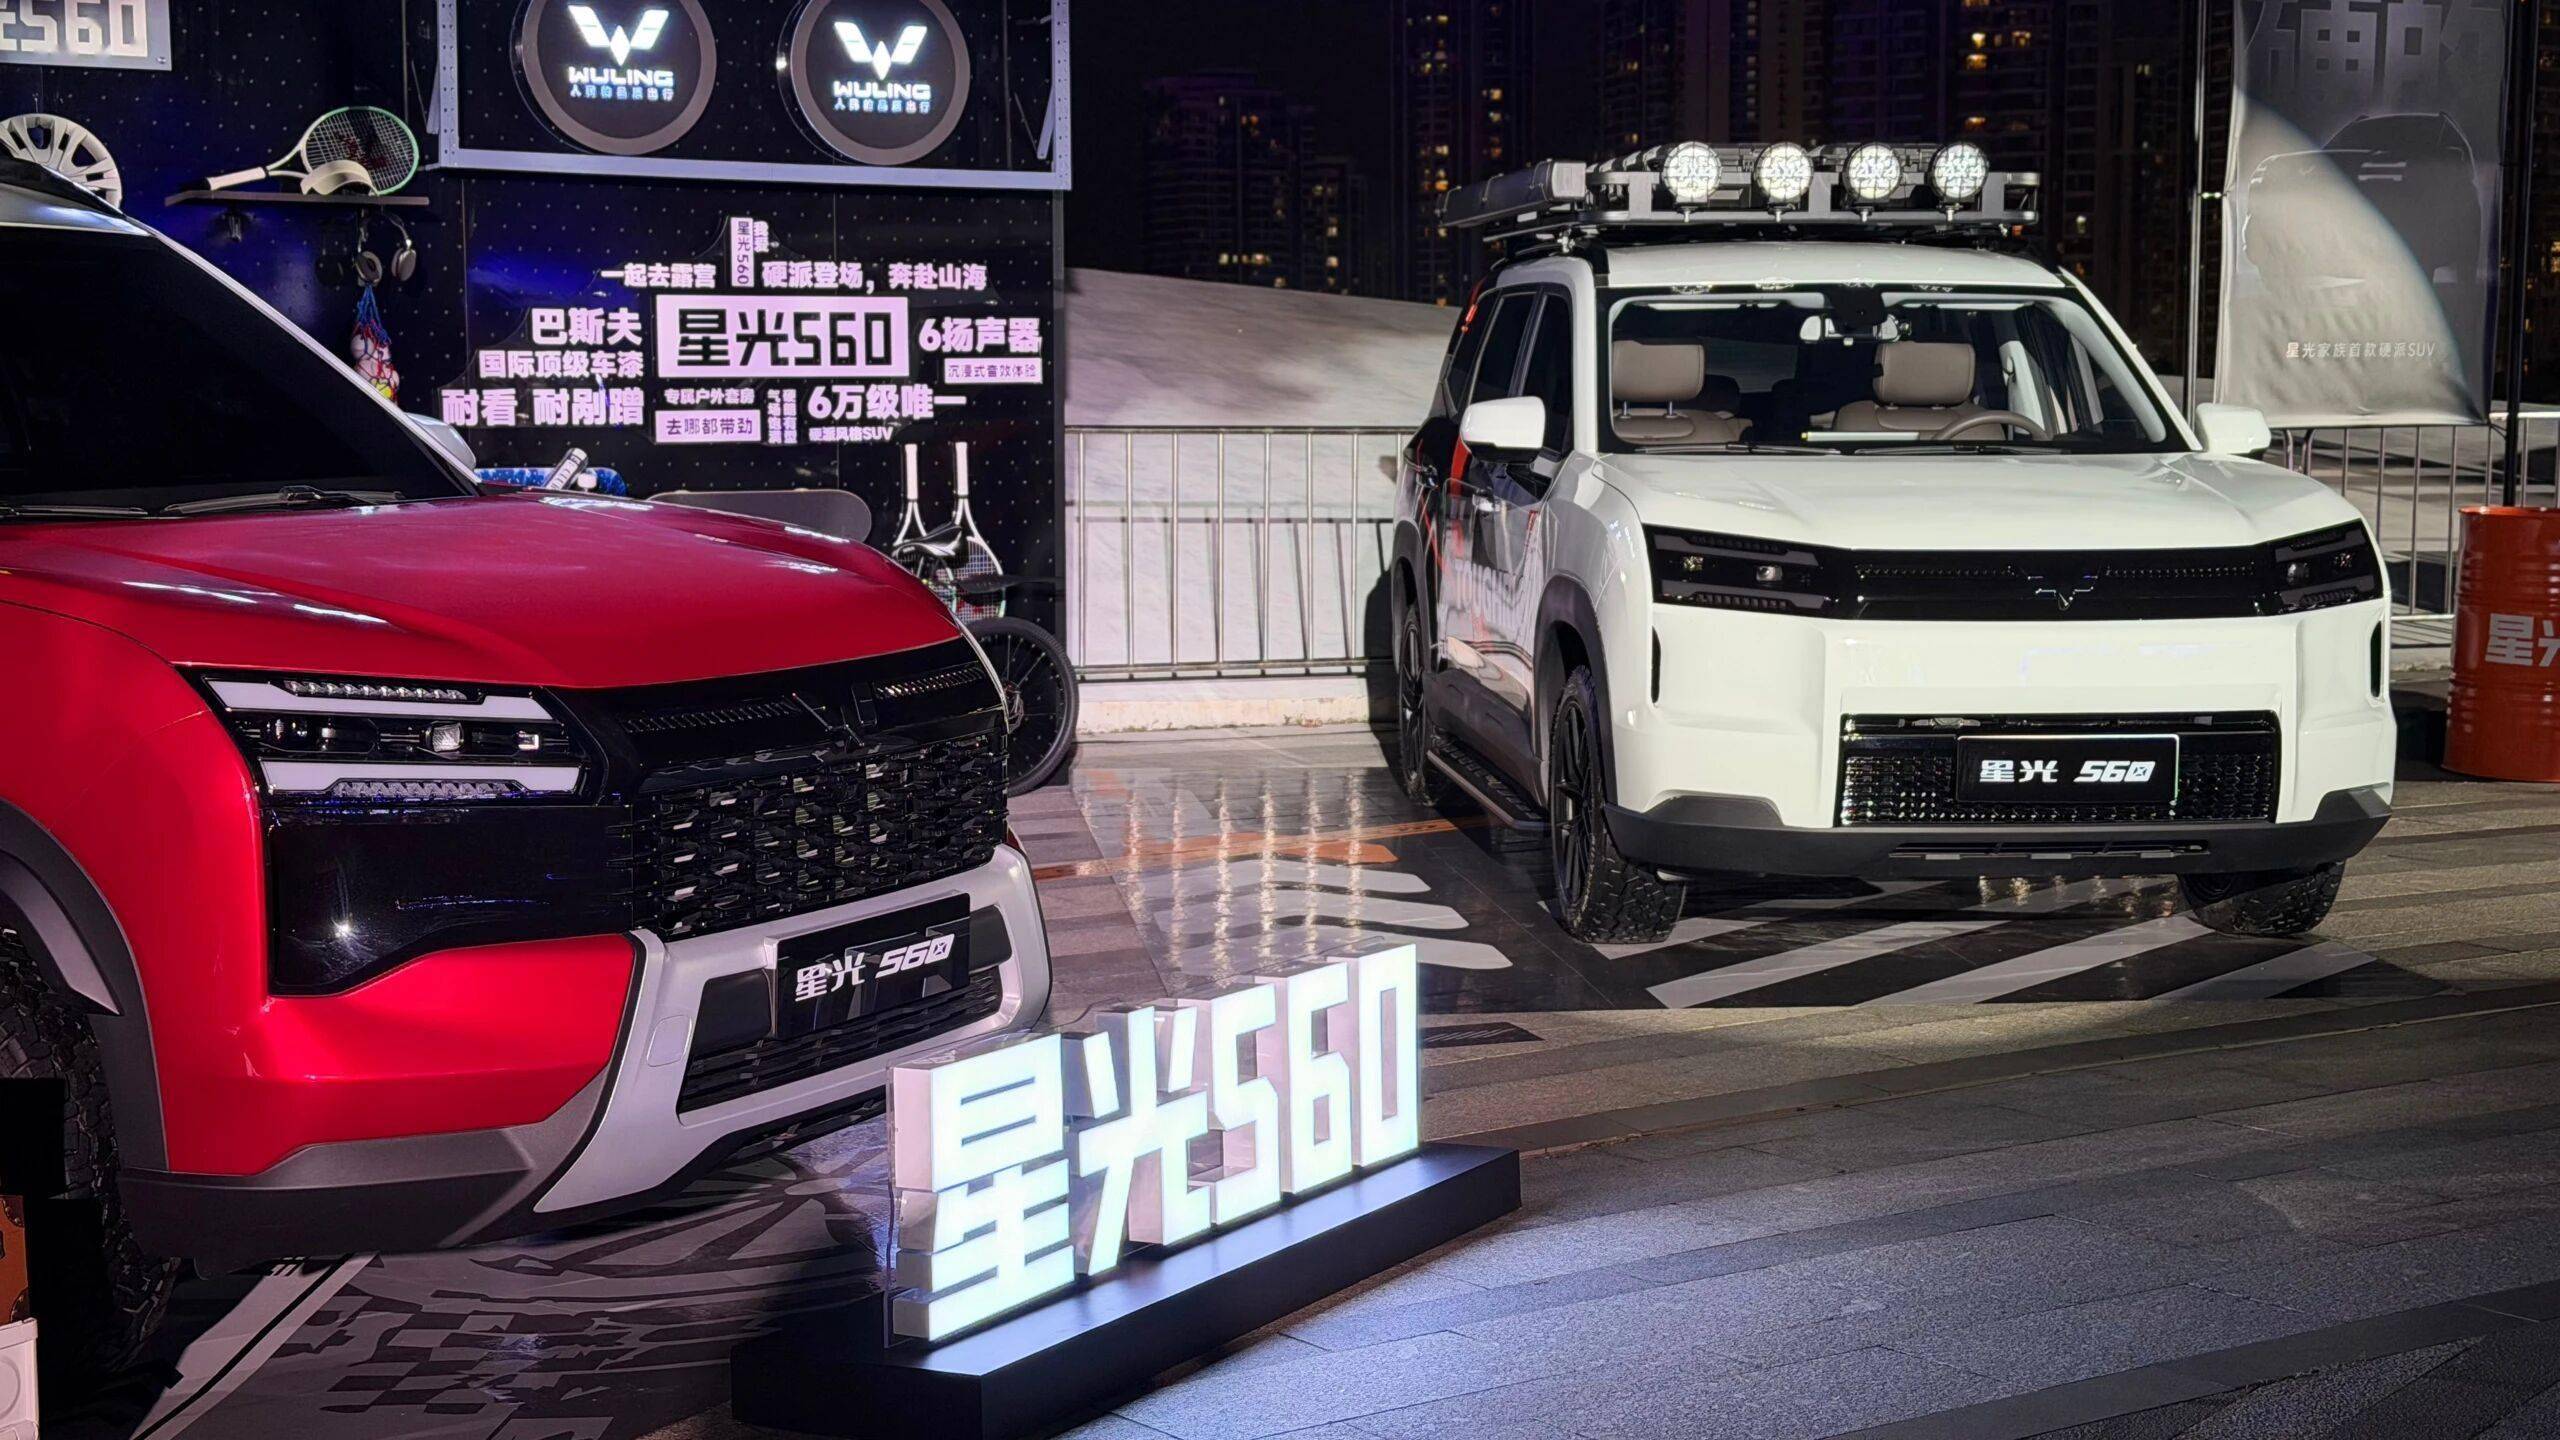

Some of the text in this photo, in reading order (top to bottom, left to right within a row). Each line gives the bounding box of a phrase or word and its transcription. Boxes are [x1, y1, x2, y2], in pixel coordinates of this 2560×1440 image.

[568, 66, 674, 87] WULING
[833, 81, 932, 100] WULING
[736, 220, 750, 284] 星光560
[601, 262, 716, 288] 一起去露营
[531, 307, 643, 346] 巴斯夫
[677, 308, 893, 367] 星光560
[918, 316, 1043, 353] 6扬声器
[478, 350, 644, 379] 国际顶级车漆
[2286, 341, 2435, 359] 星光家族首款硬派SUV
[948, 364, 1036, 378] 沉浸式音效体验
[441, 387, 645, 426] 耐看 耐剐蹭
[808, 383, 967, 420] 6万级唯一
[666, 417, 753, 436] 去哪都带劲
[1980, 759, 2156, 783] 星光 560
[795, 933, 955, 1002] 星光 560
[928, 943, 1421, 1343] 星光560
